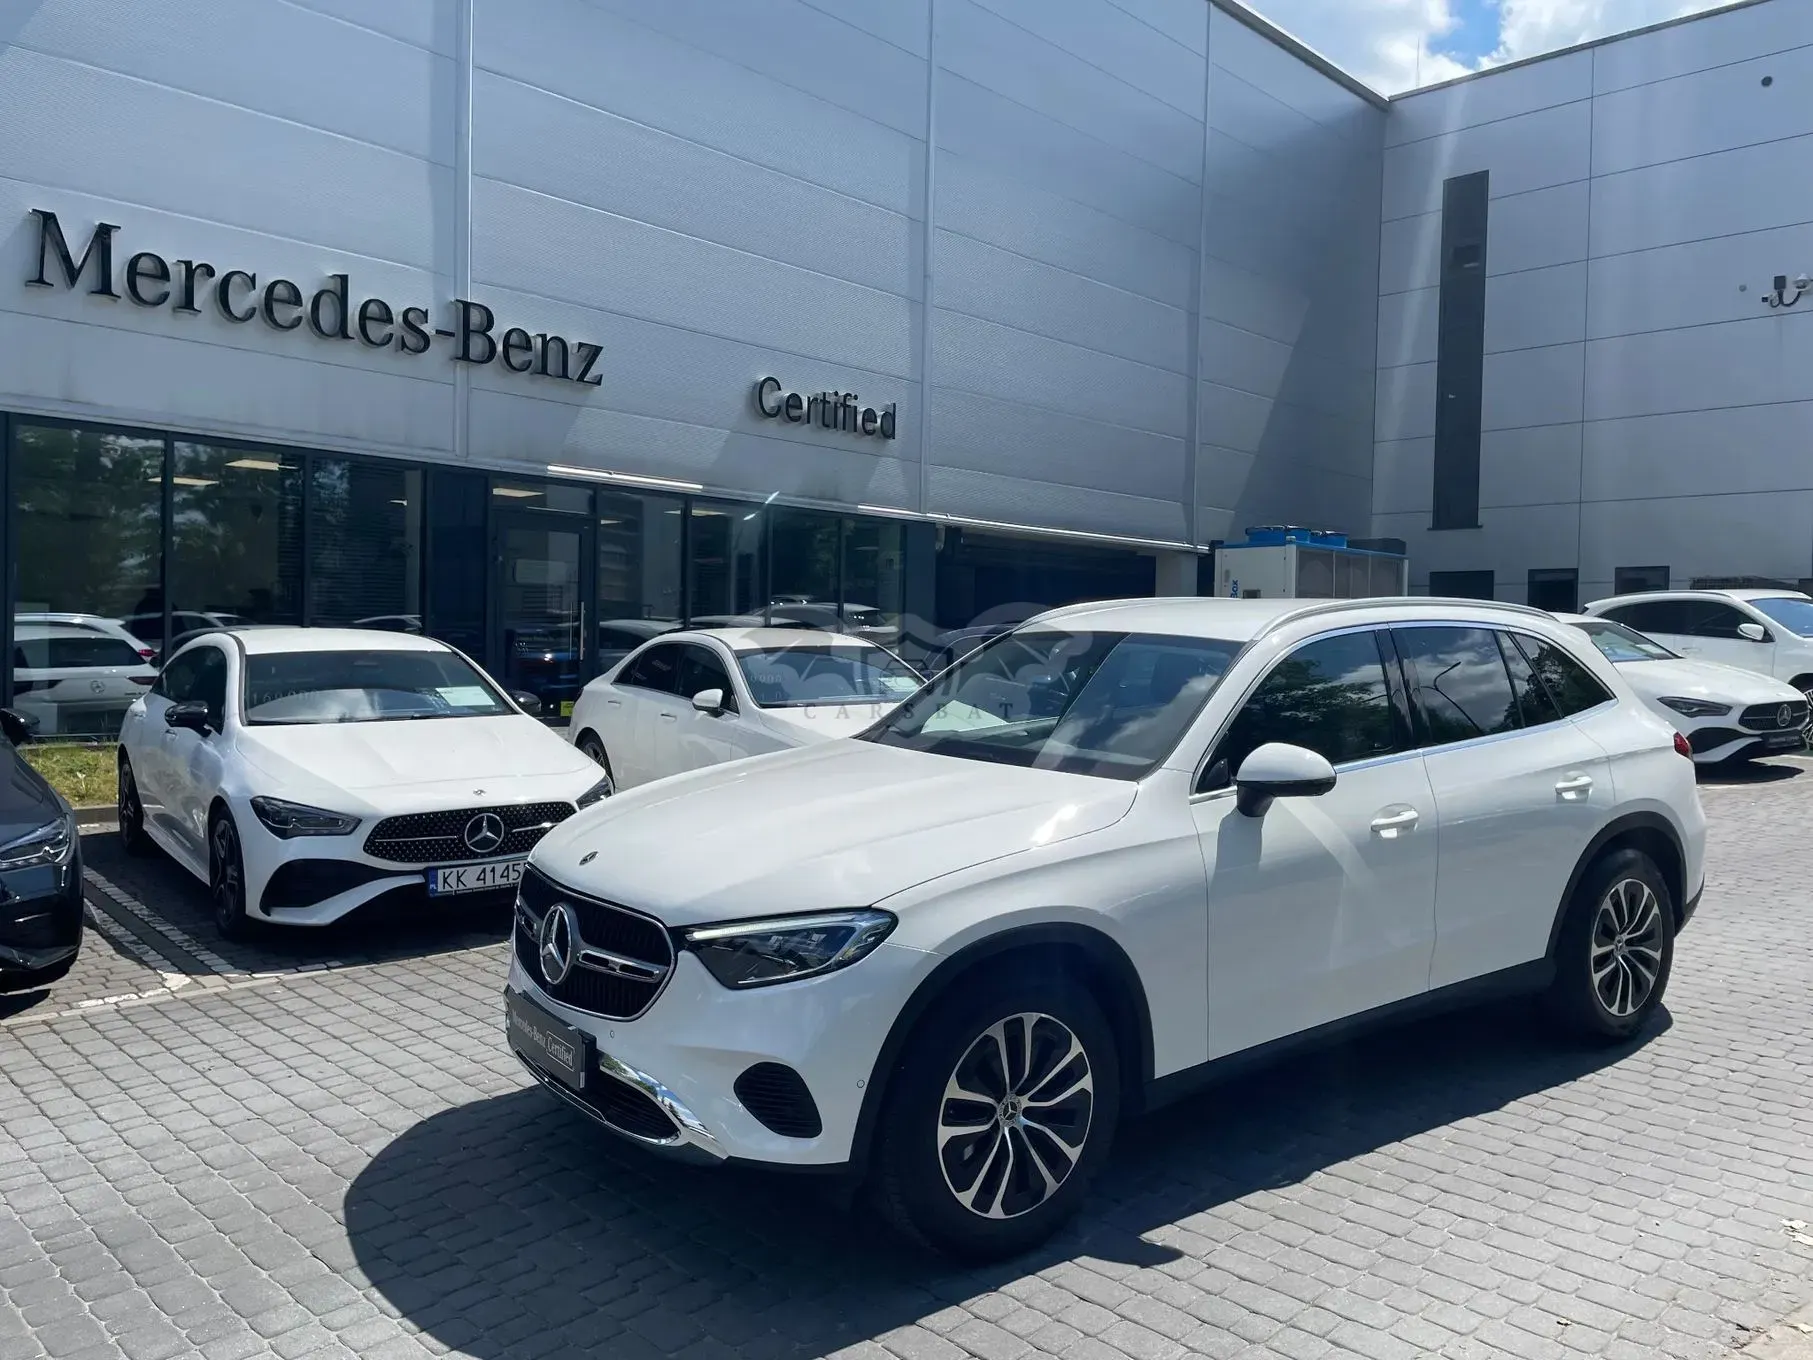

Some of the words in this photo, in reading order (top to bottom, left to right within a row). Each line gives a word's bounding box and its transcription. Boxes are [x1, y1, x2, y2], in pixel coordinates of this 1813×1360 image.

[25, 208, 604, 387] Mercedes-Benz
[755, 376, 896, 440] Certified
[442, 869, 467, 890] KK
[476, 862, 526, 885] 4145
[547, 1036, 573, 1066] Certified
